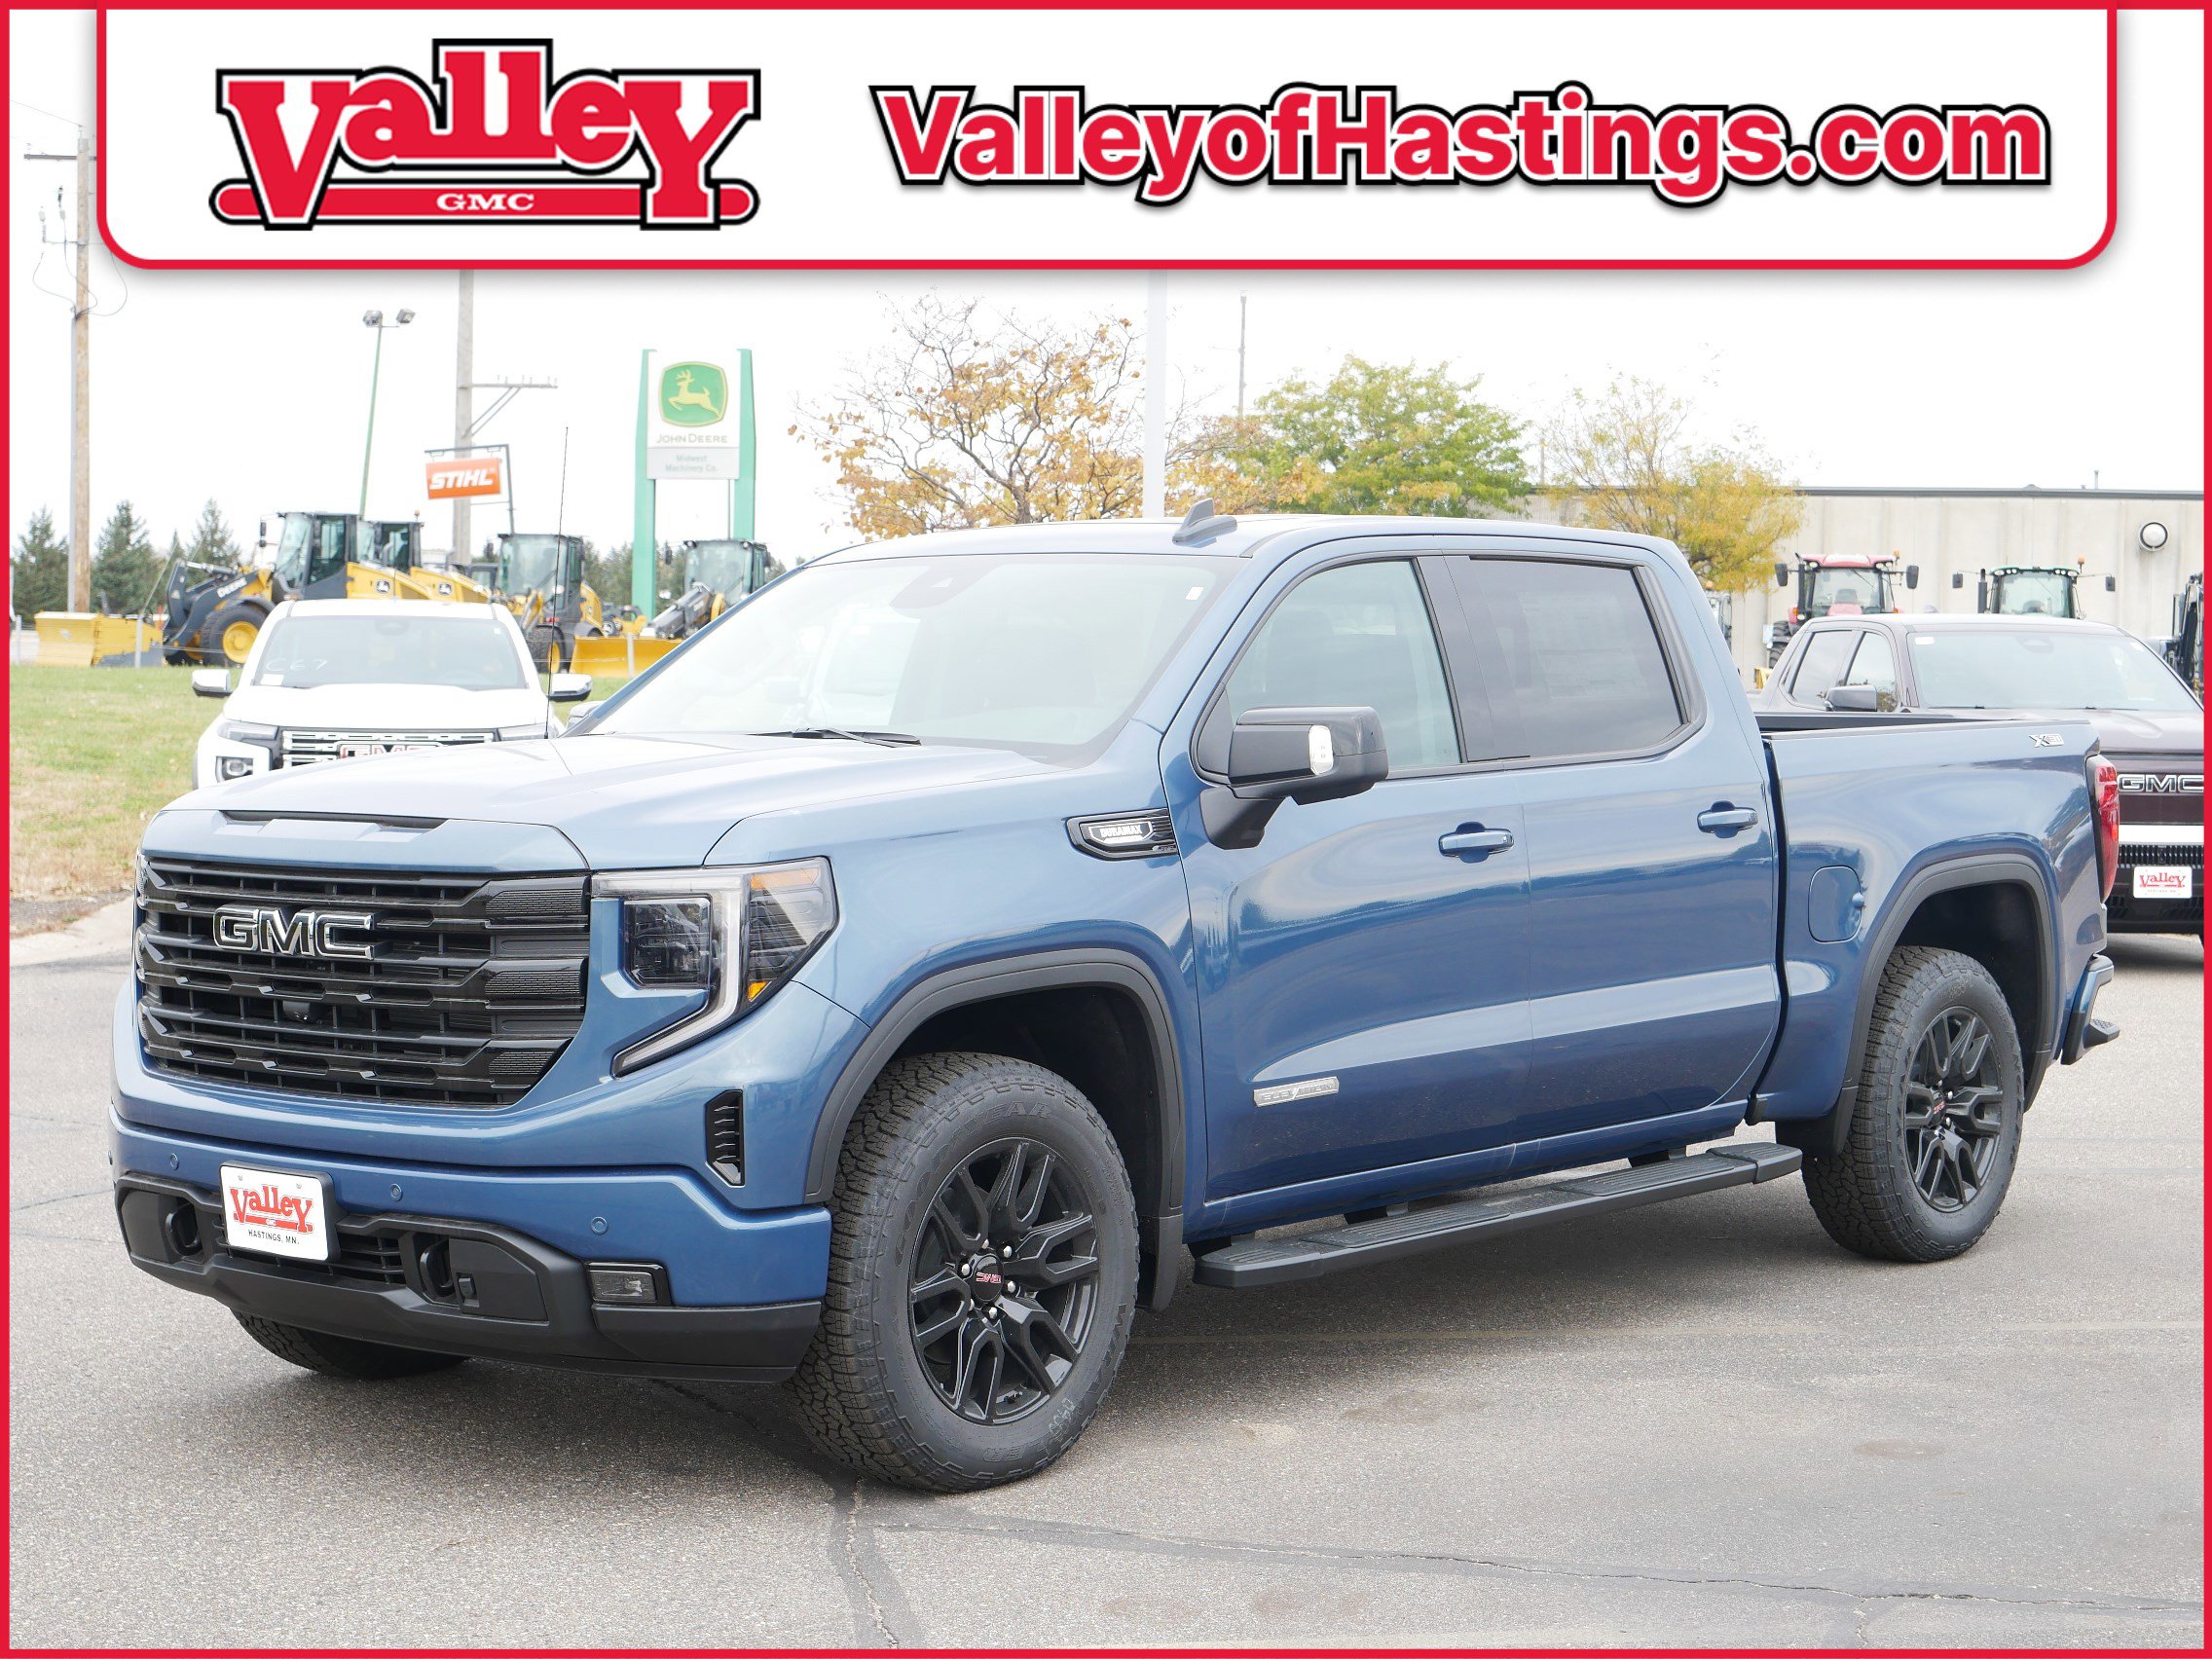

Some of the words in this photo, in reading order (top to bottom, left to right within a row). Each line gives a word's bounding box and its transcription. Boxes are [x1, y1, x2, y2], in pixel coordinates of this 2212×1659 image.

[656, 433, 686, 444] JOHN
[688, 433, 728, 444] DEERE
[429, 469, 494, 490] STIHL
[2117, 774, 2204, 793] GMC
[212, 907, 376, 961] GMC
